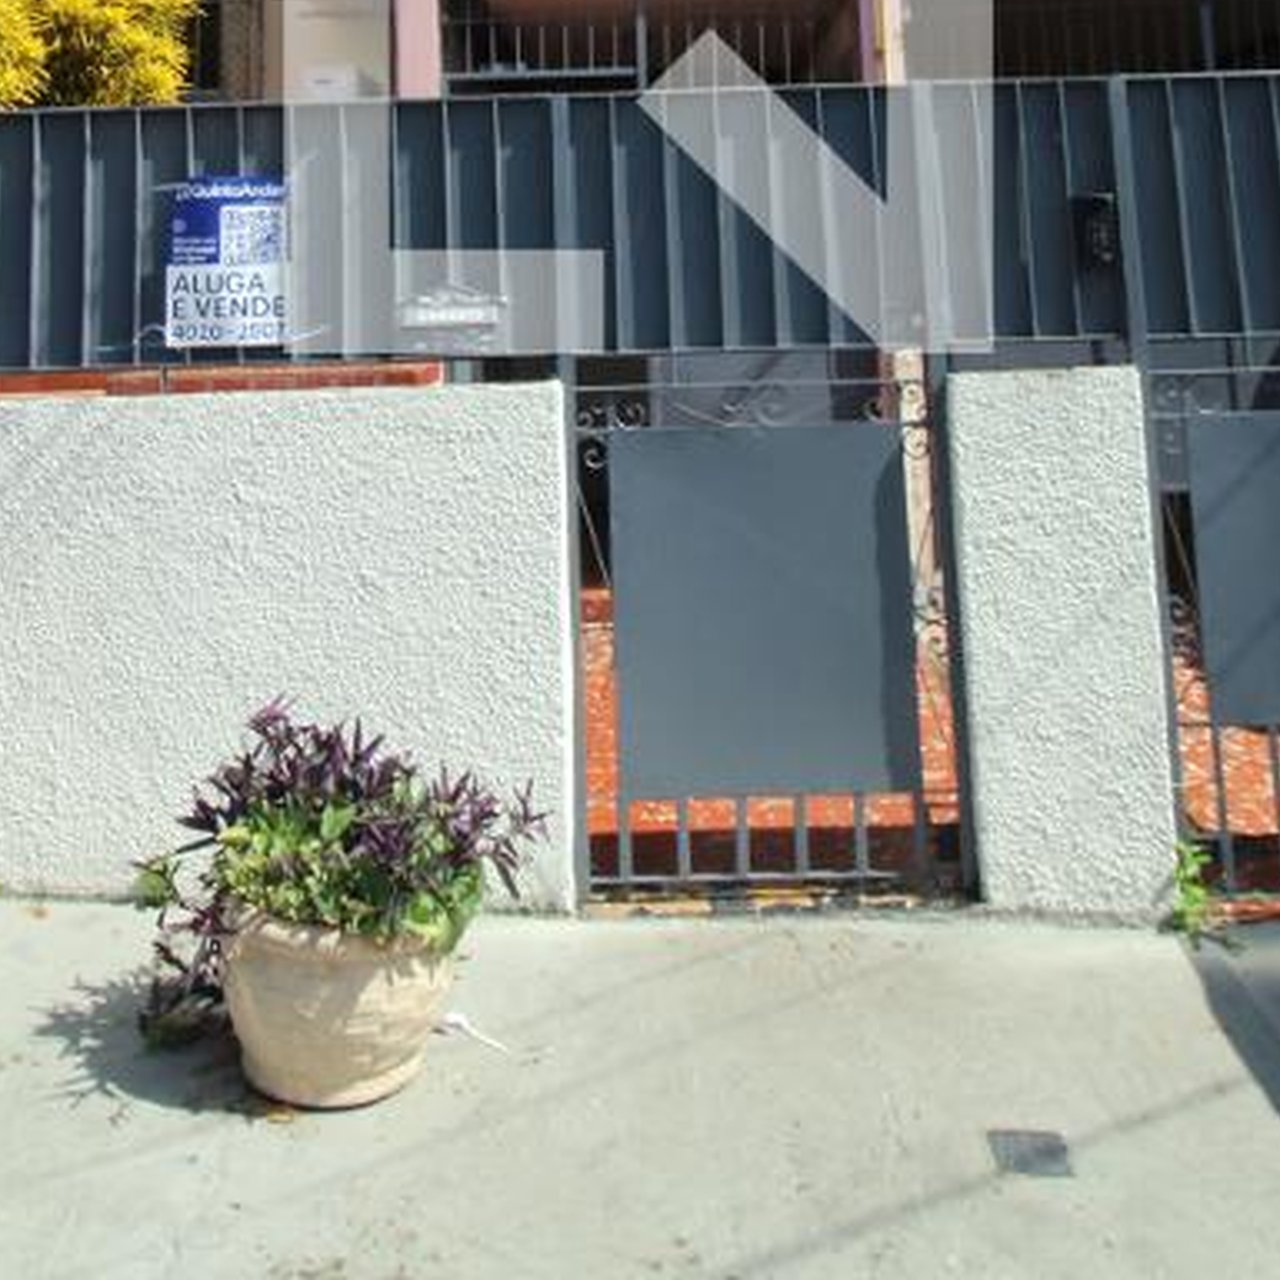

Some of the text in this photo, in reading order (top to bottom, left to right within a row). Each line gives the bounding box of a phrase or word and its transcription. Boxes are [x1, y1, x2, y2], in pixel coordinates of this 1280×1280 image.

[172, 272, 265, 295] ALUGA
[173, 295, 285, 319] E VENDE
